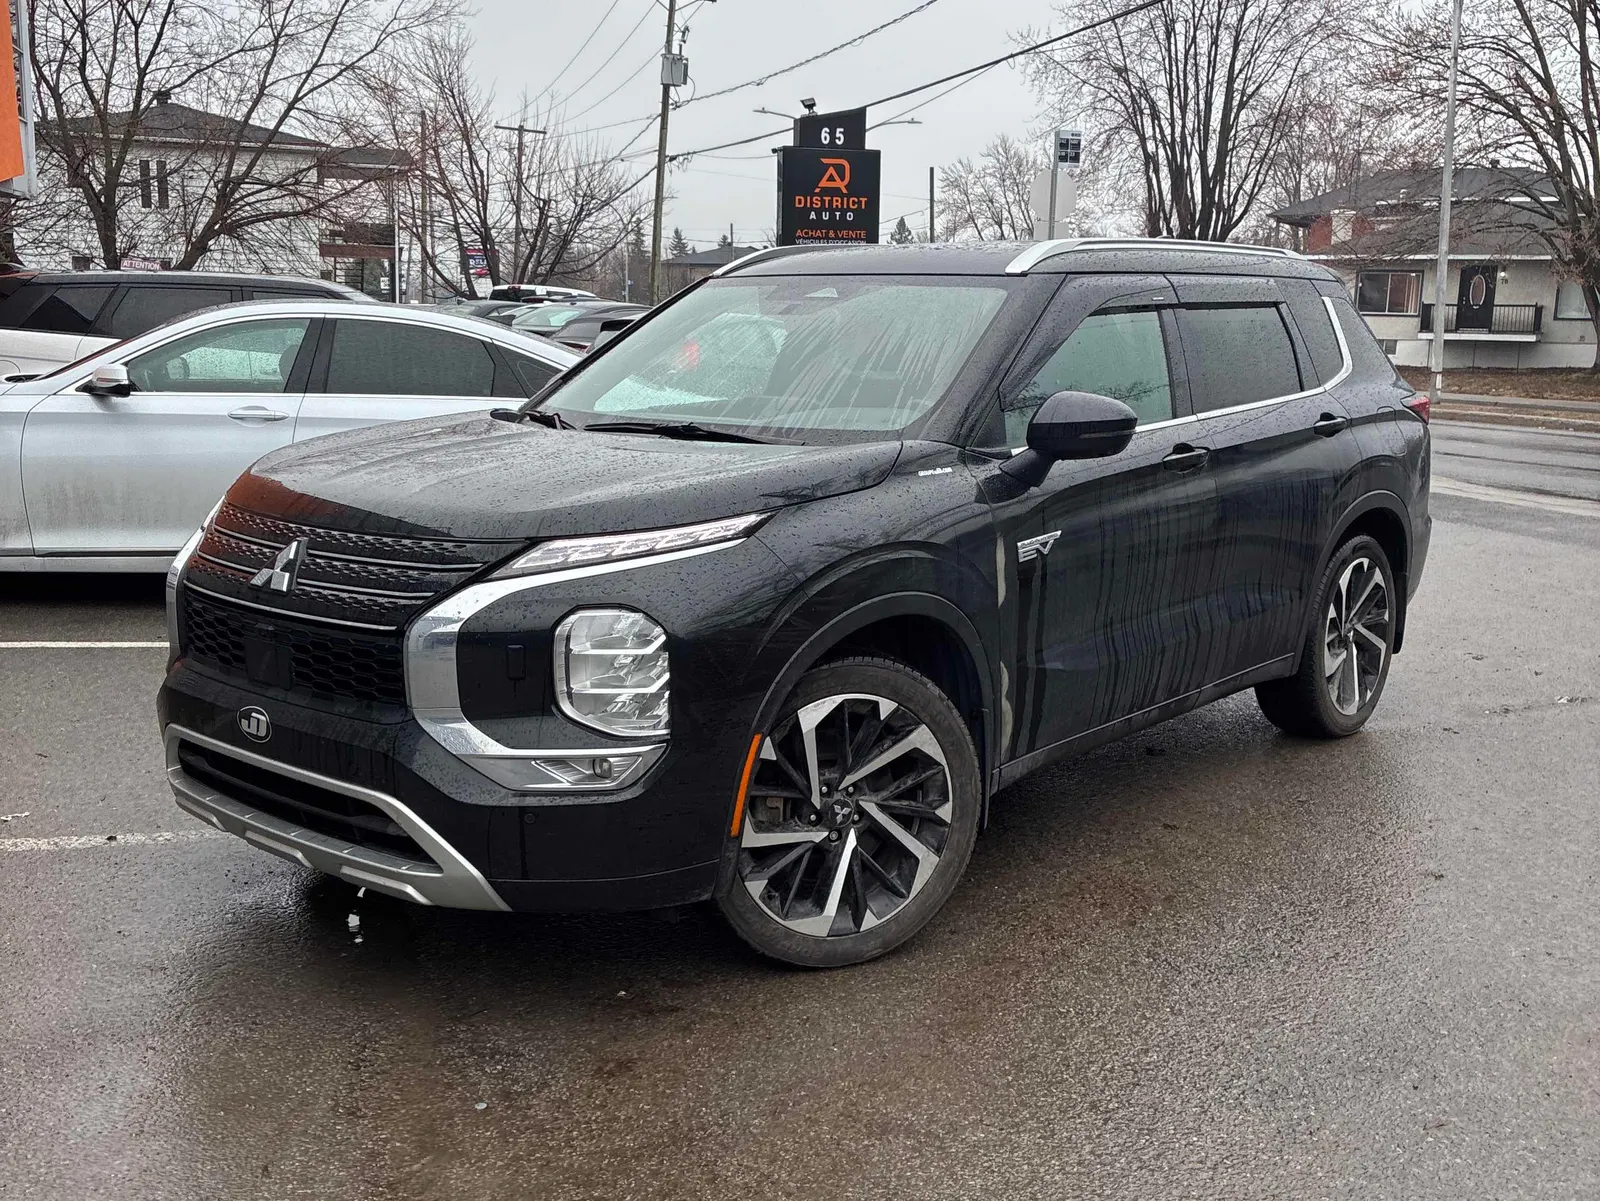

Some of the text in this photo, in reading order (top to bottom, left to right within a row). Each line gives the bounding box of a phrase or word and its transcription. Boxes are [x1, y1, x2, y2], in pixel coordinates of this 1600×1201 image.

[820, 127, 845, 145] 65
[794, 195, 868, 209] DISTRICT
[809, 210, 854, 221] AUTO
[795, 229, 867, 239] ACHAT & VENTE
[122, 260, 160, 270] ATTENTION
[1017, 539, 1055, 563] EV
